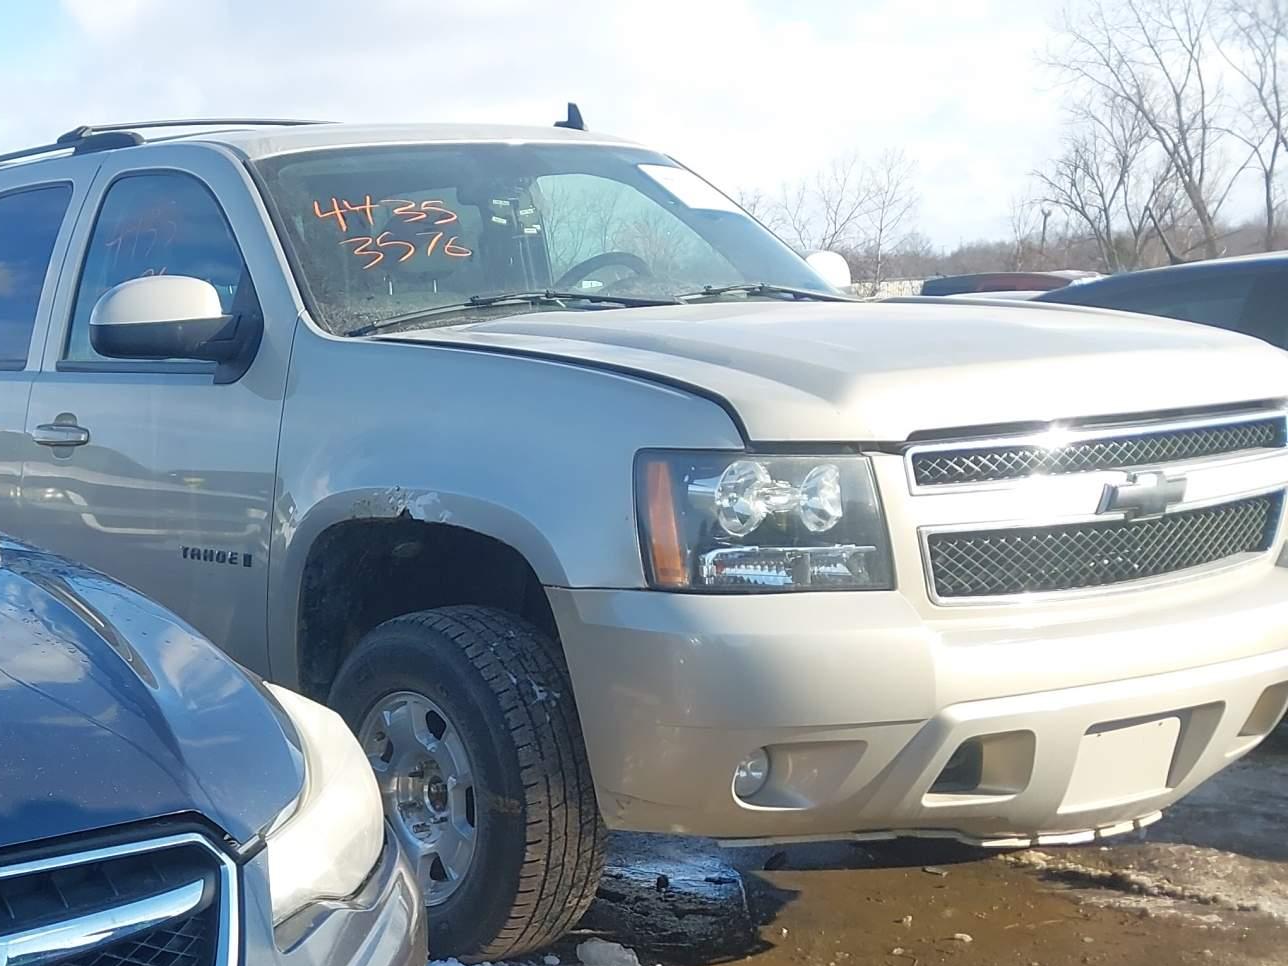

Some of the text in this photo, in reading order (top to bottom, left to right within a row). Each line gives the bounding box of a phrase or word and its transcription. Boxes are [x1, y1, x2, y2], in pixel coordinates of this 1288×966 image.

[314, 195, 458, 232] 4435
[339, 231, 472, 269] 3576
[181, 546, 239, 565] TAHOE
